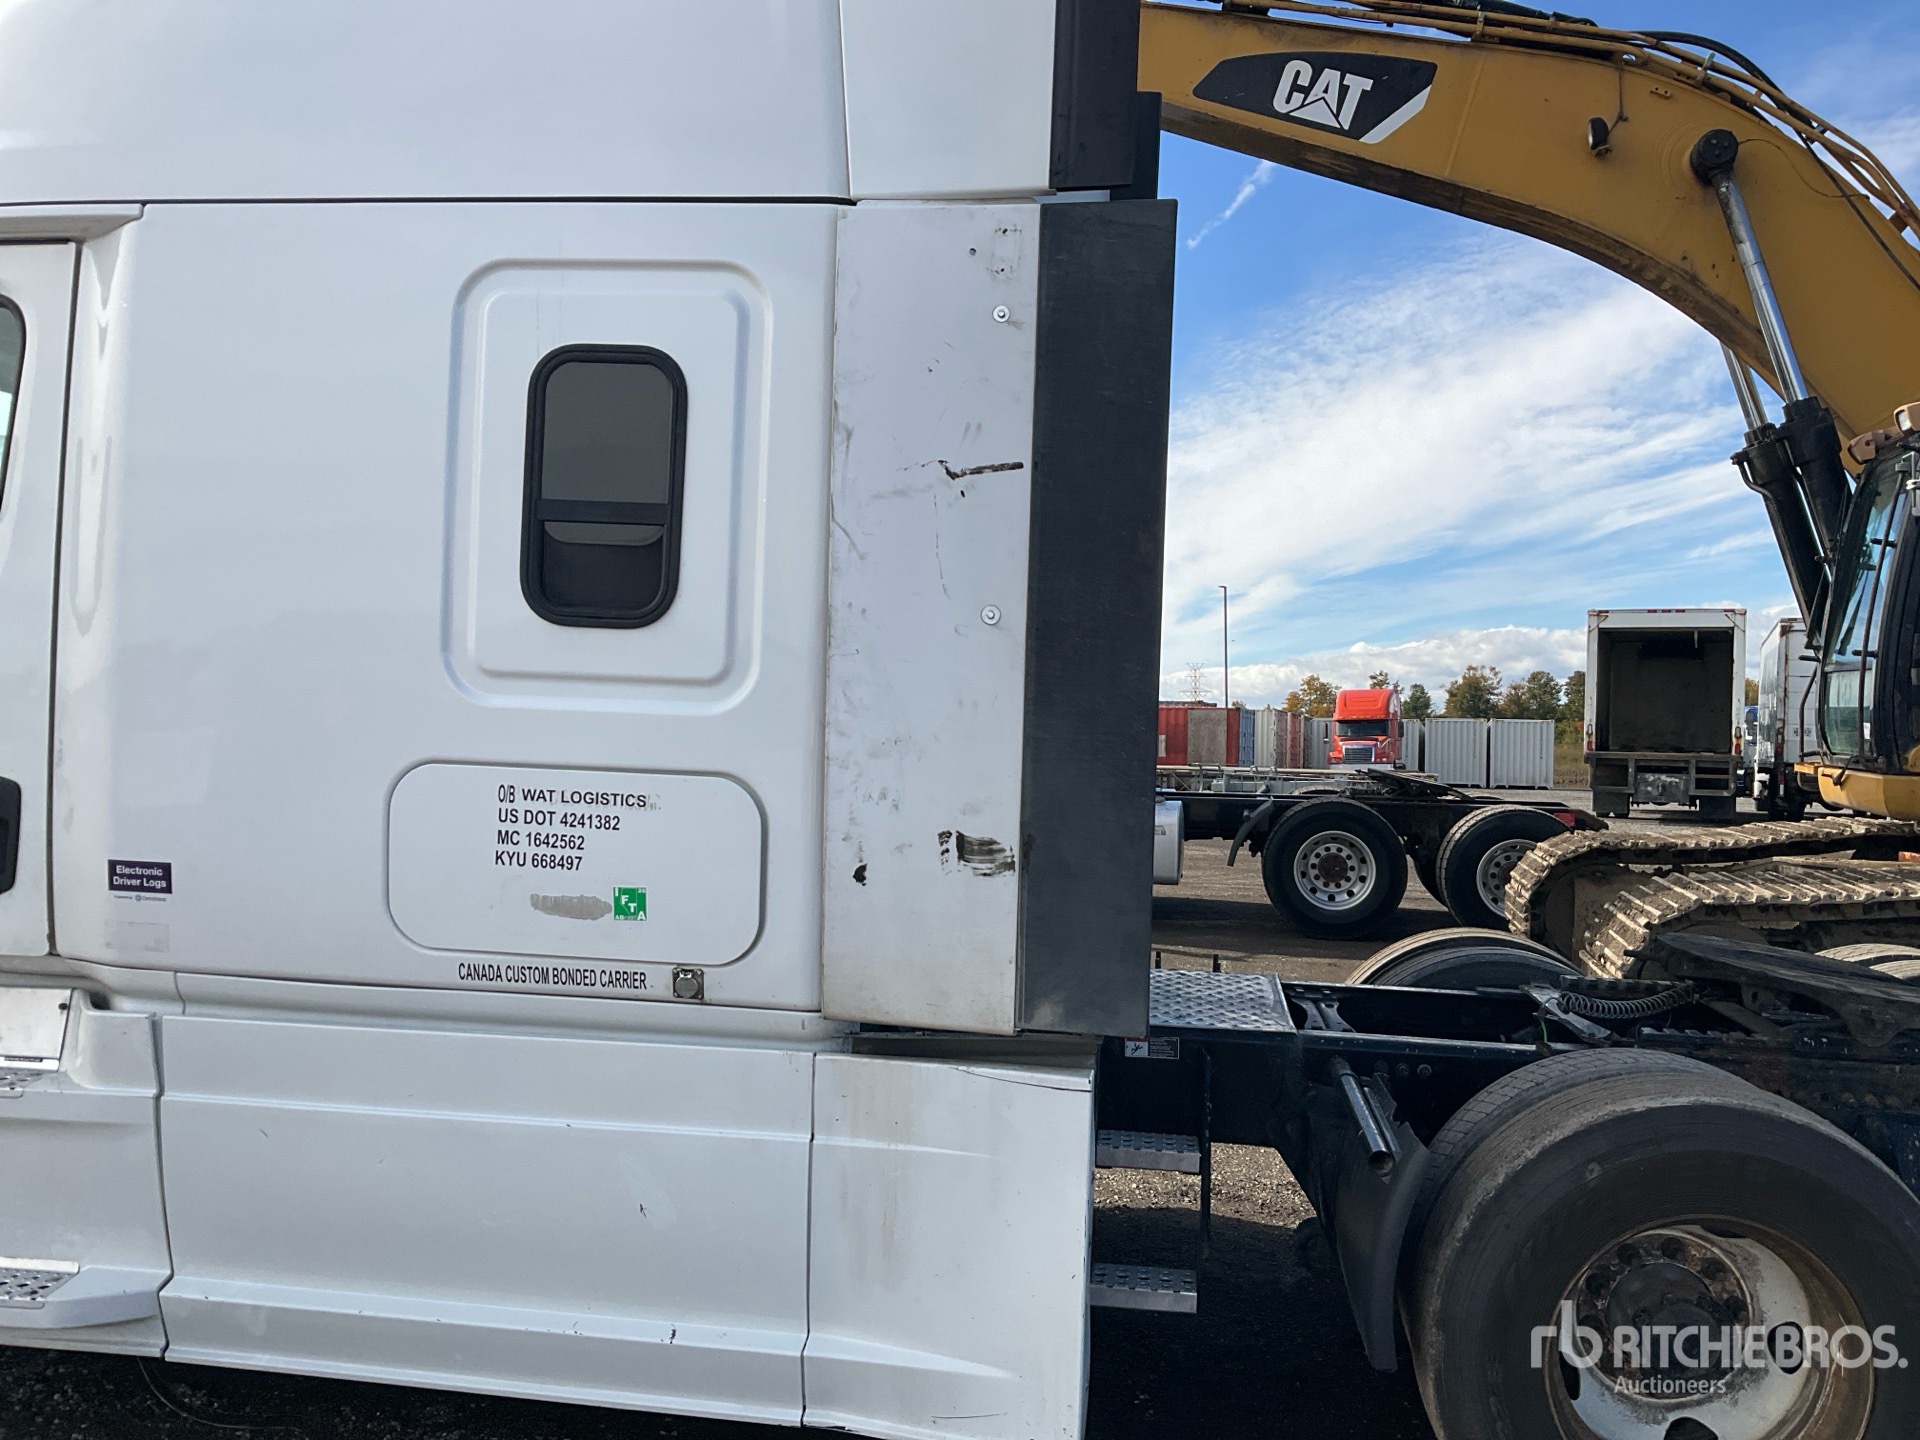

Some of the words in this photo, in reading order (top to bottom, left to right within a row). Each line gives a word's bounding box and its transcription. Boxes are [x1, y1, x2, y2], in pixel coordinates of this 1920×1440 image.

[1273, 59, 1374, 131] CAT
[498, 784, 516, 804] O/B
[522, 788, 556, 803] WAT
[560, 790, 647, 808] LOGISTICS
[498, 807, 519, 824] US
[524, 809, 556, 827] DOT
[560, 812, 621, 831] 4241382
[497, 829, 520, 846] MC
[525, 831, 585, 851] 1642562
[116, 865, 163, 876] Electronic
[495, 850, 527, 867] KYU
[531, 853, 583, 871] 668497
[113, 876, 141, 886] Driver
[143, 878, 167, 889] Logs
[458, 962, 503, 983] CANADA
[505, 965, 550, 984] CUSTOM
[552, 967, 597, 987] BONDED
[600, 970, 647, 990] CARRIER
